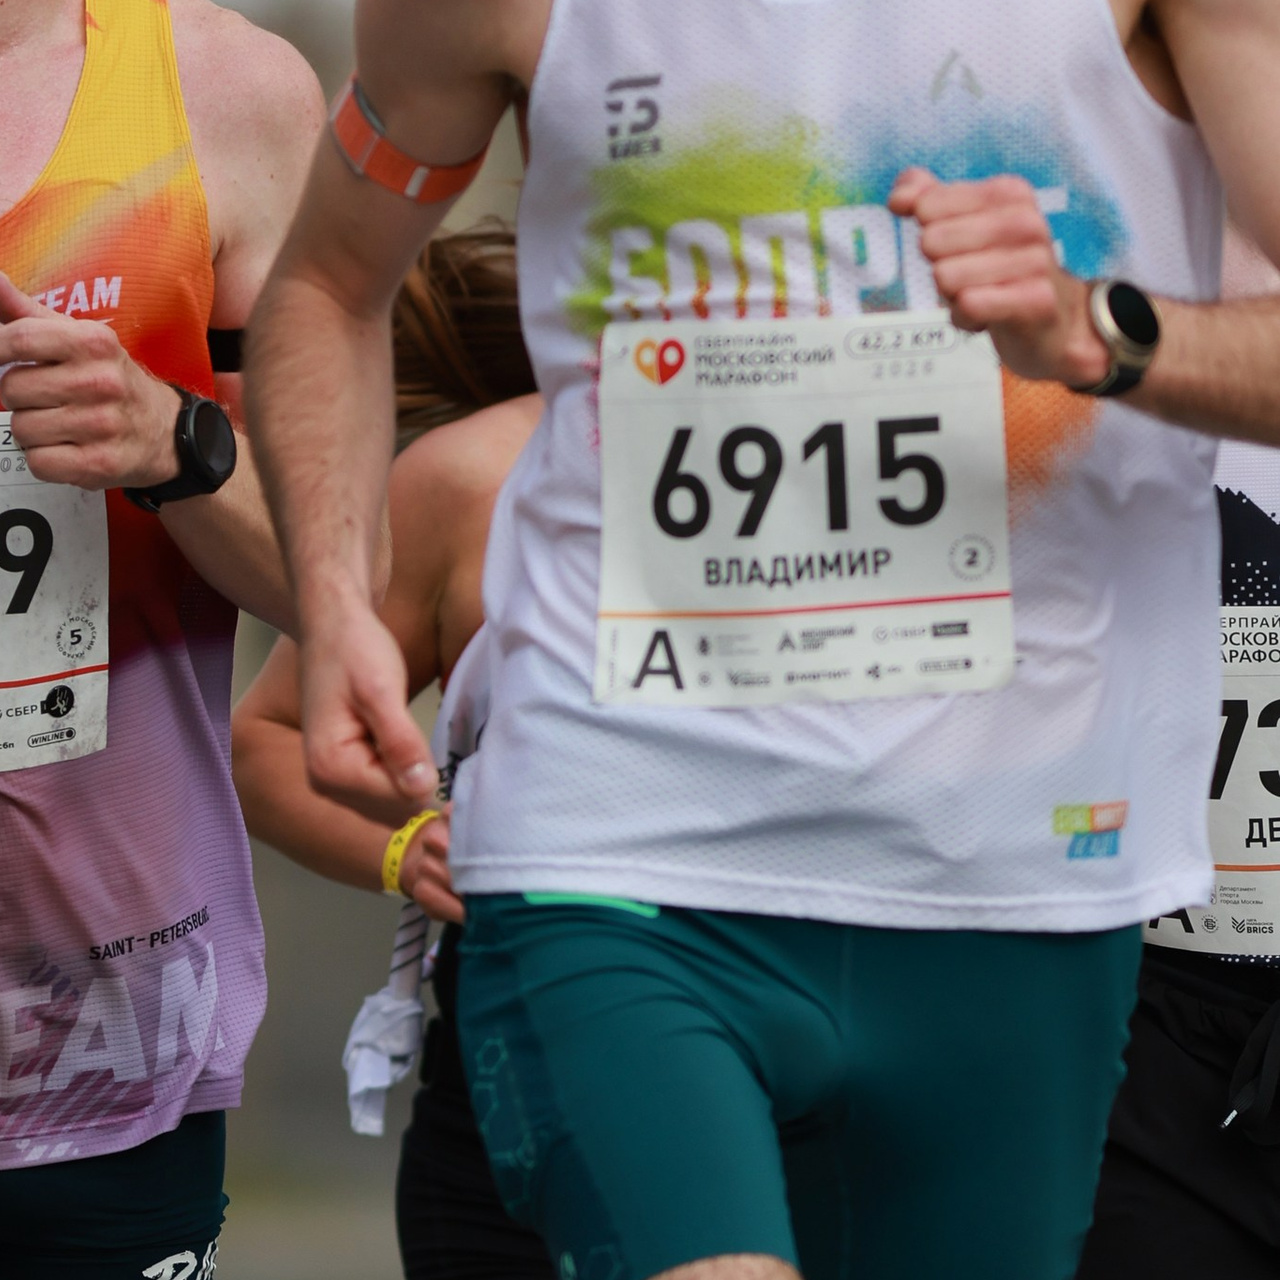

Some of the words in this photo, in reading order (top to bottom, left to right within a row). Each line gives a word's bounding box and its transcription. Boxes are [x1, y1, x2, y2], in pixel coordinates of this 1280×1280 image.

[32, 276, 122, 316] EAM
[652, 414, 946, 539] 6915
[704, 547, 892, 589] ВЛАДИМИР
[70, 628, 82, 646] 5
[5, 704, 38, 718] СБЕР
[31, 731, 65, 746] WINLINE
[1246, 926, 1274, 934] BRICS
